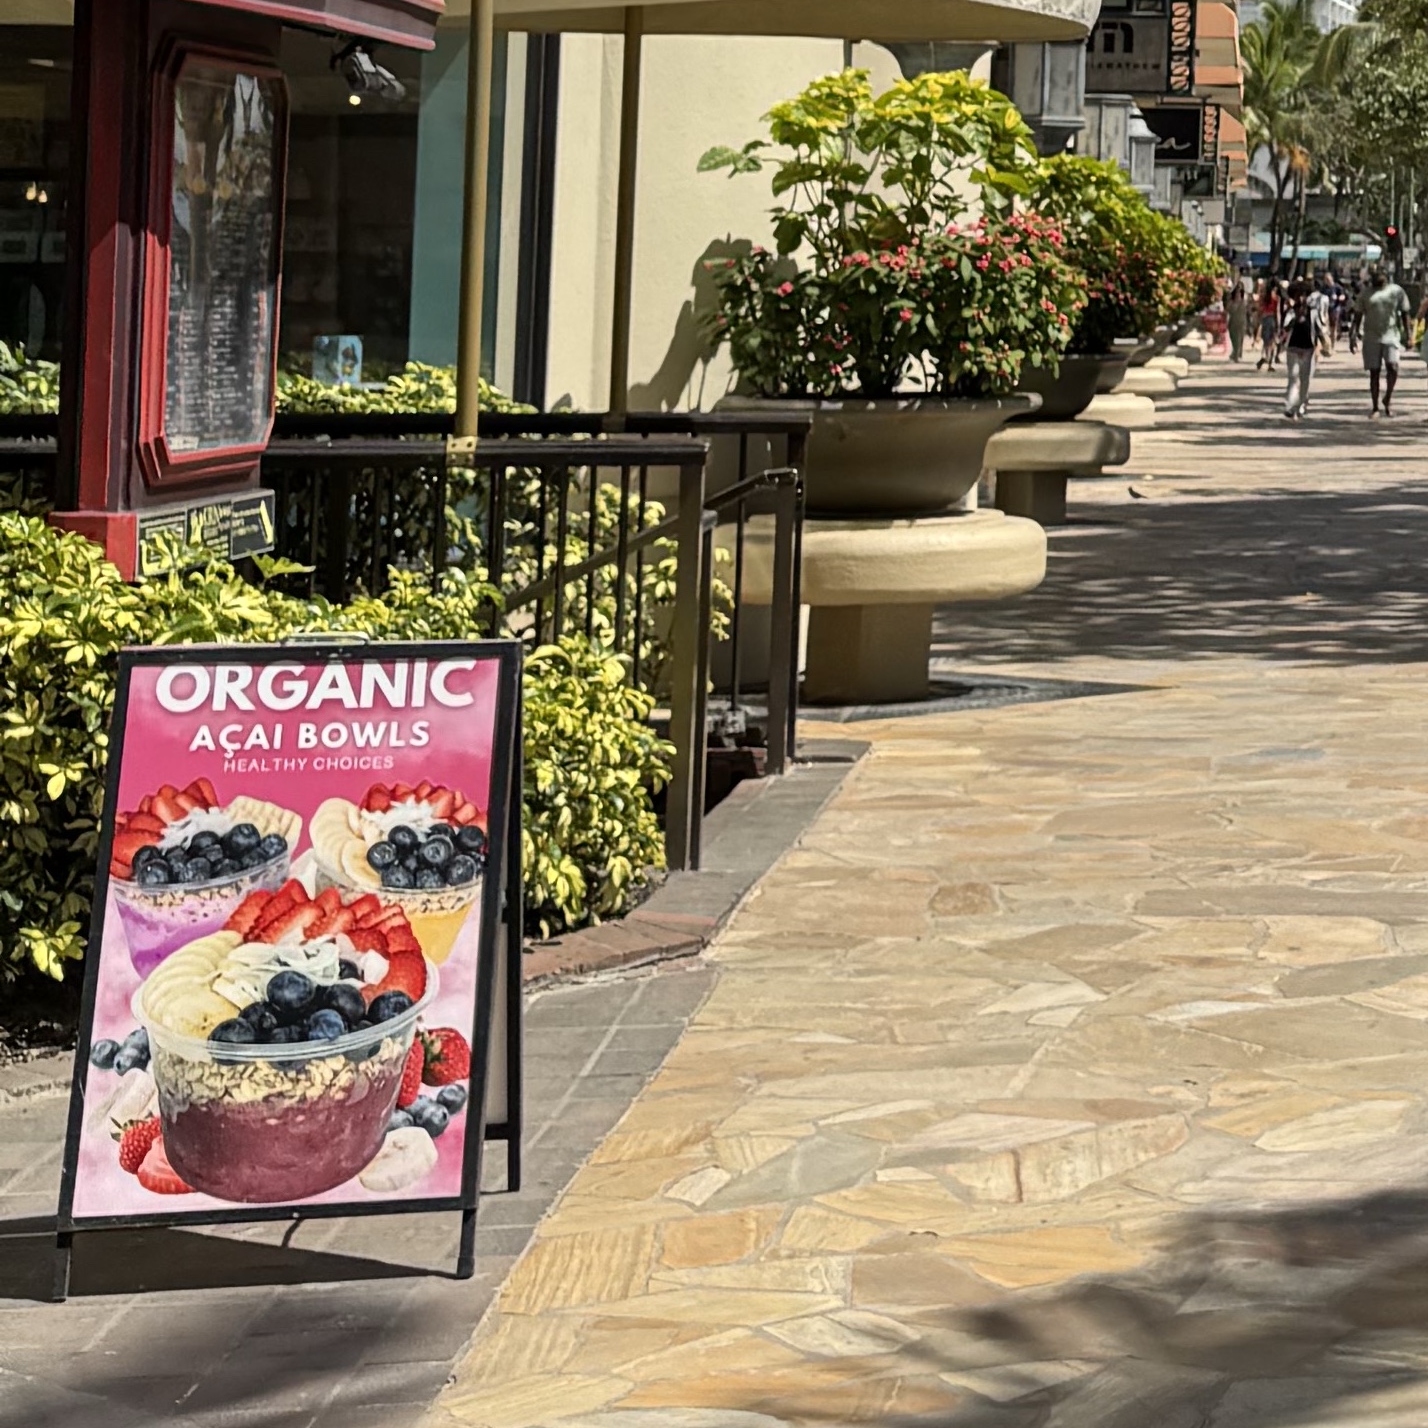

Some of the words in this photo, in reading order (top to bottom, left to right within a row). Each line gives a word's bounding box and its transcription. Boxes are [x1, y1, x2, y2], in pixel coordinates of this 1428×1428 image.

[155, 658, 477, 713] ORGANIC
[189, 723, 282, 759] AÇAI
[298, 721, 430, 749] BOWLS
[224, 757, 308, 773] HEALTHY
[312, 755, 395, 771] CHOICES
